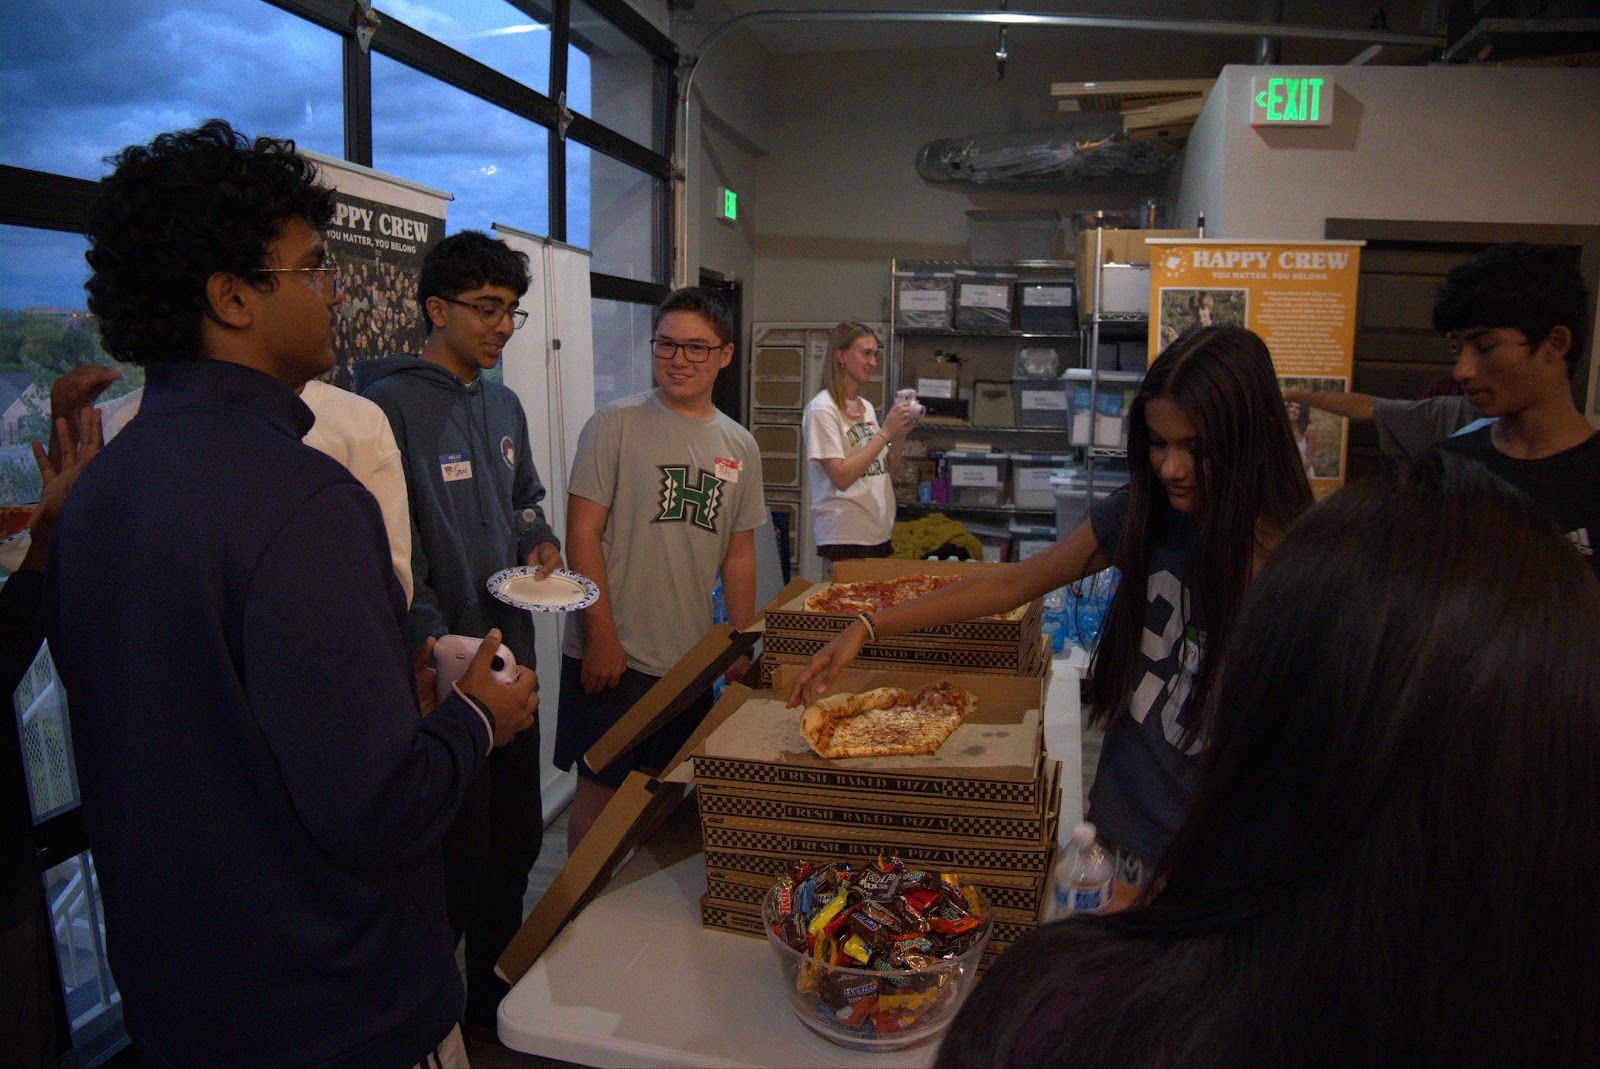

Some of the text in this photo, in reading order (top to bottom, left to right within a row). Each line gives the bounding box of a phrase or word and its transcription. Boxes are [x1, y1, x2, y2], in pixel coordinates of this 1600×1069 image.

[1266, 78, 1325, 121] EXIT
[330, 202, 429, 243] PPY CREW
[326, 229, 417, 254] YOU MATTER, YOU BELONG
[1192, 250, 1349, 271] HAPPY CREW
[1211, 271, 1230, 280] YOU
[1272, 272, 1291, 281] YOU
[1292, 272, 1329, 281] BELONG
[655, 465, 723, 531] H
[870, 649, 949, 661] BAKED PIZZA
[781, 770, 941, 792] FRESH BAKED PIZZA
[788, 807, 946, 829] FRESH BAKED PIZZA
[793, 839, 840, 853] FRESH
[908, 848, 952, 862] PIZZA
